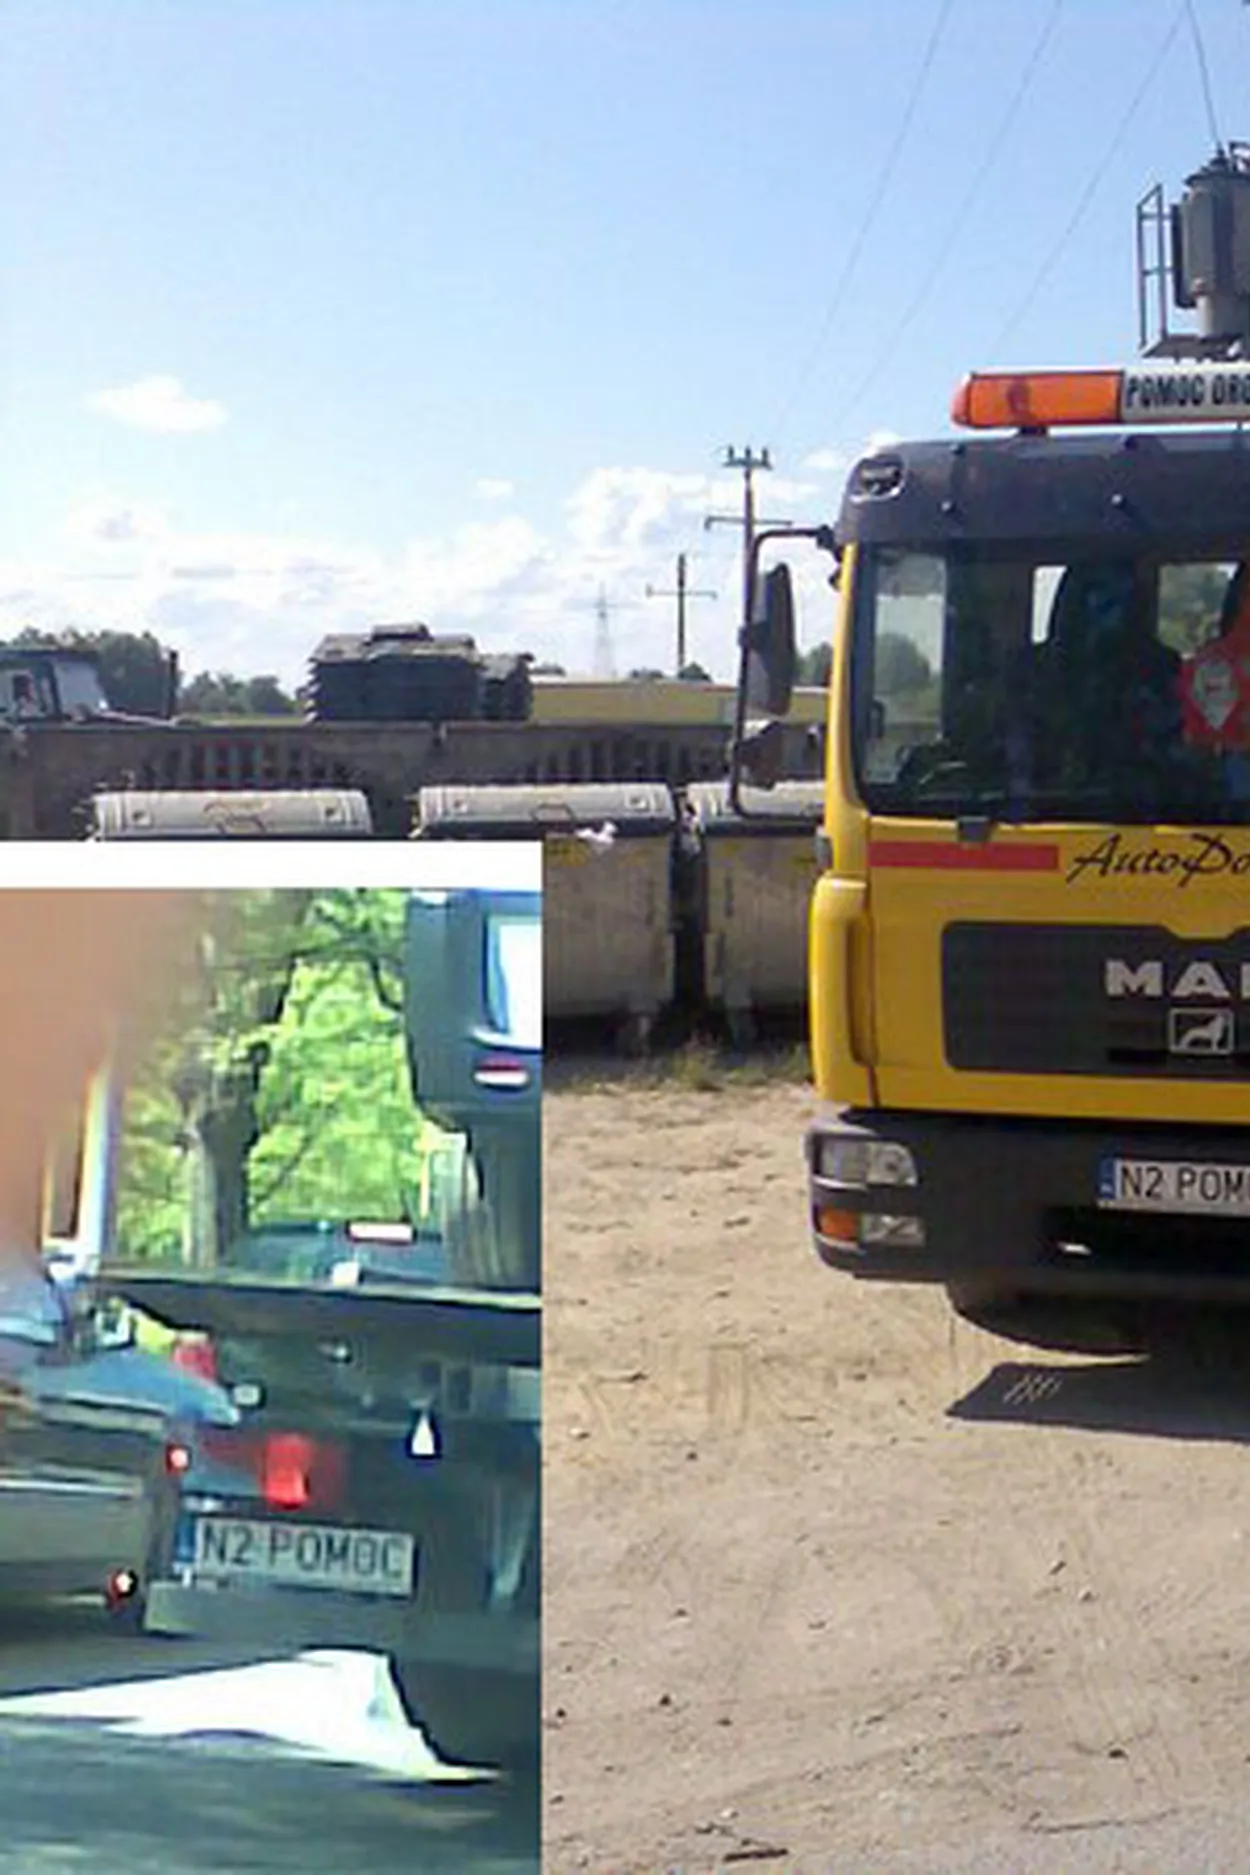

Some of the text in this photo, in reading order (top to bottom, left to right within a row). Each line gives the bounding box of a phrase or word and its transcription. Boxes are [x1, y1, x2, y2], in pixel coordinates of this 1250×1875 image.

[1126, 373, 1206, 408] POMOC
[1120, 1166, 1164, 1198] N2
[202, 1523, 405, 1579] N2 POMOC
